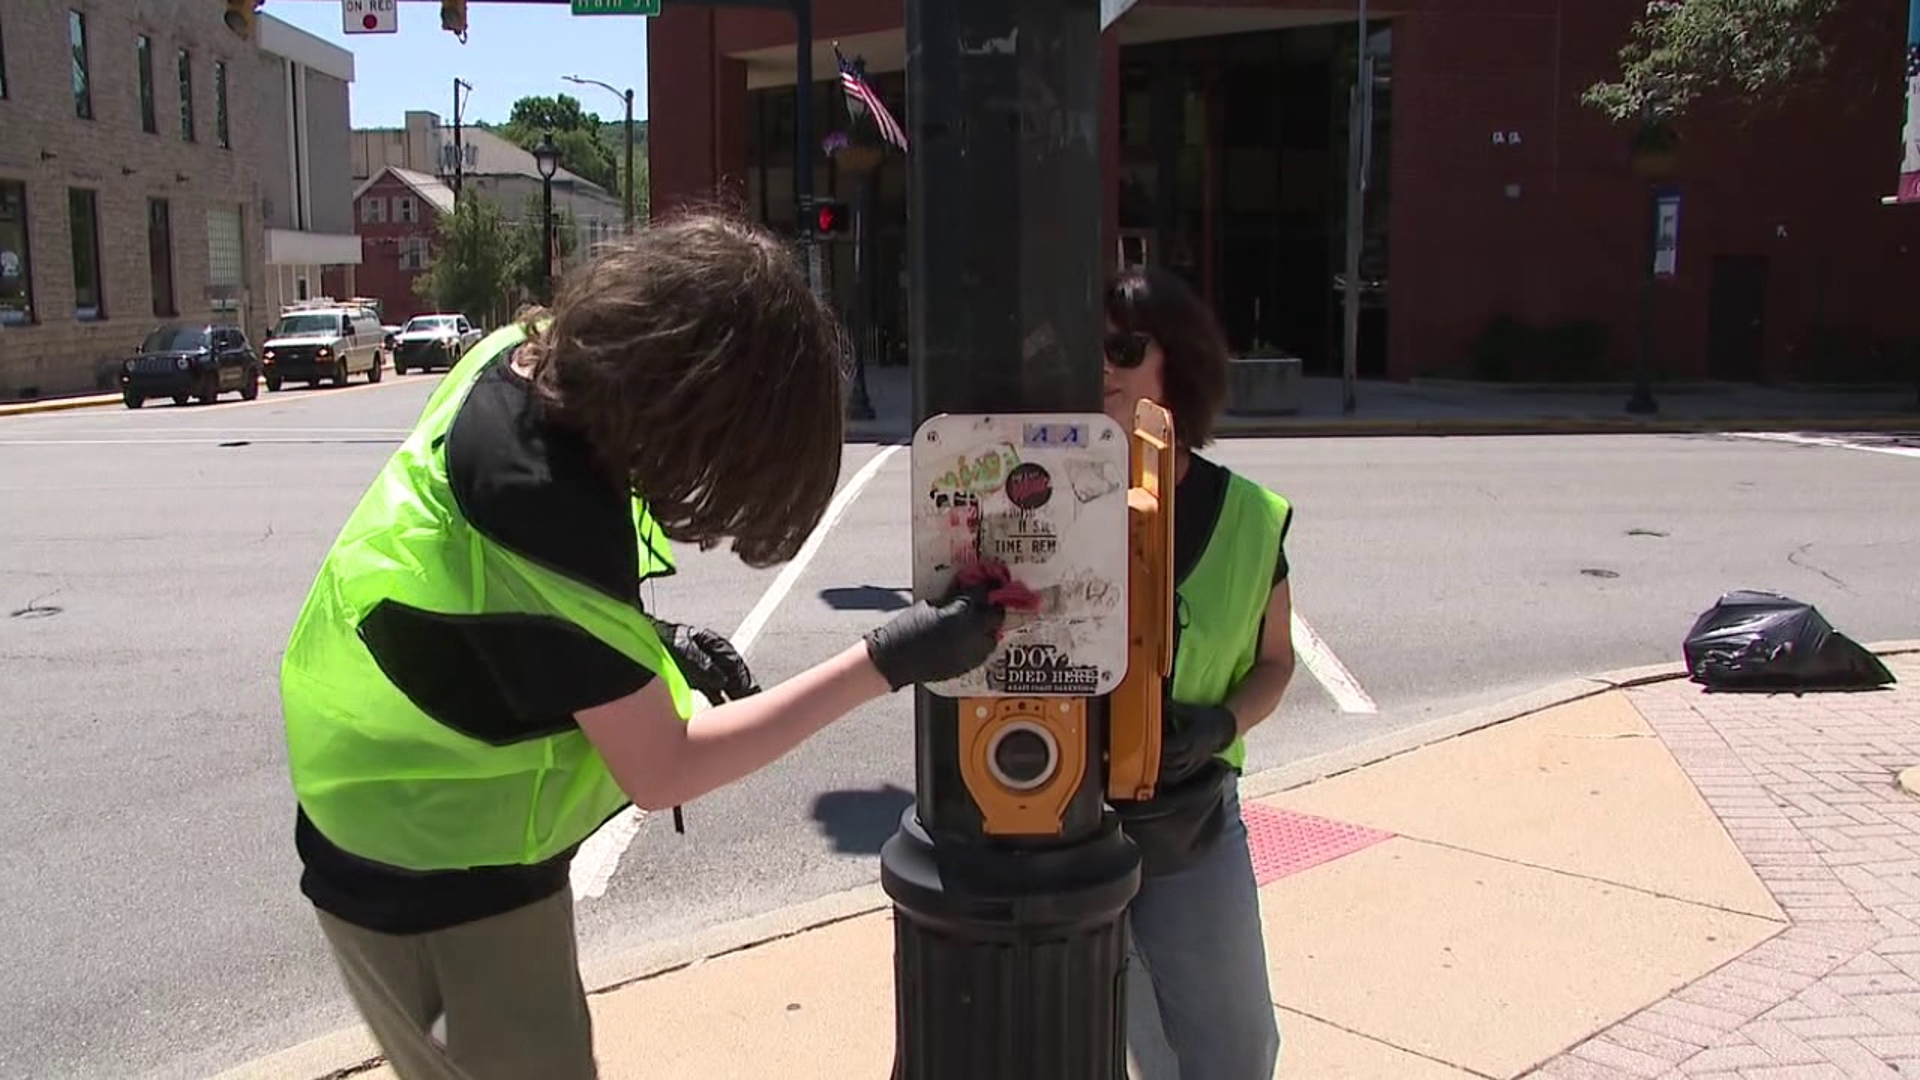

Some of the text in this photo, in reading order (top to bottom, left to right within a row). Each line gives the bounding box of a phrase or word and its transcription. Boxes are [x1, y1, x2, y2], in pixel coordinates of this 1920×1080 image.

[347, 0, 394, 12] ON RED
[995, 539, 1022, 553] TIME
[1008, 669, 1096, 683] DIED HERE
